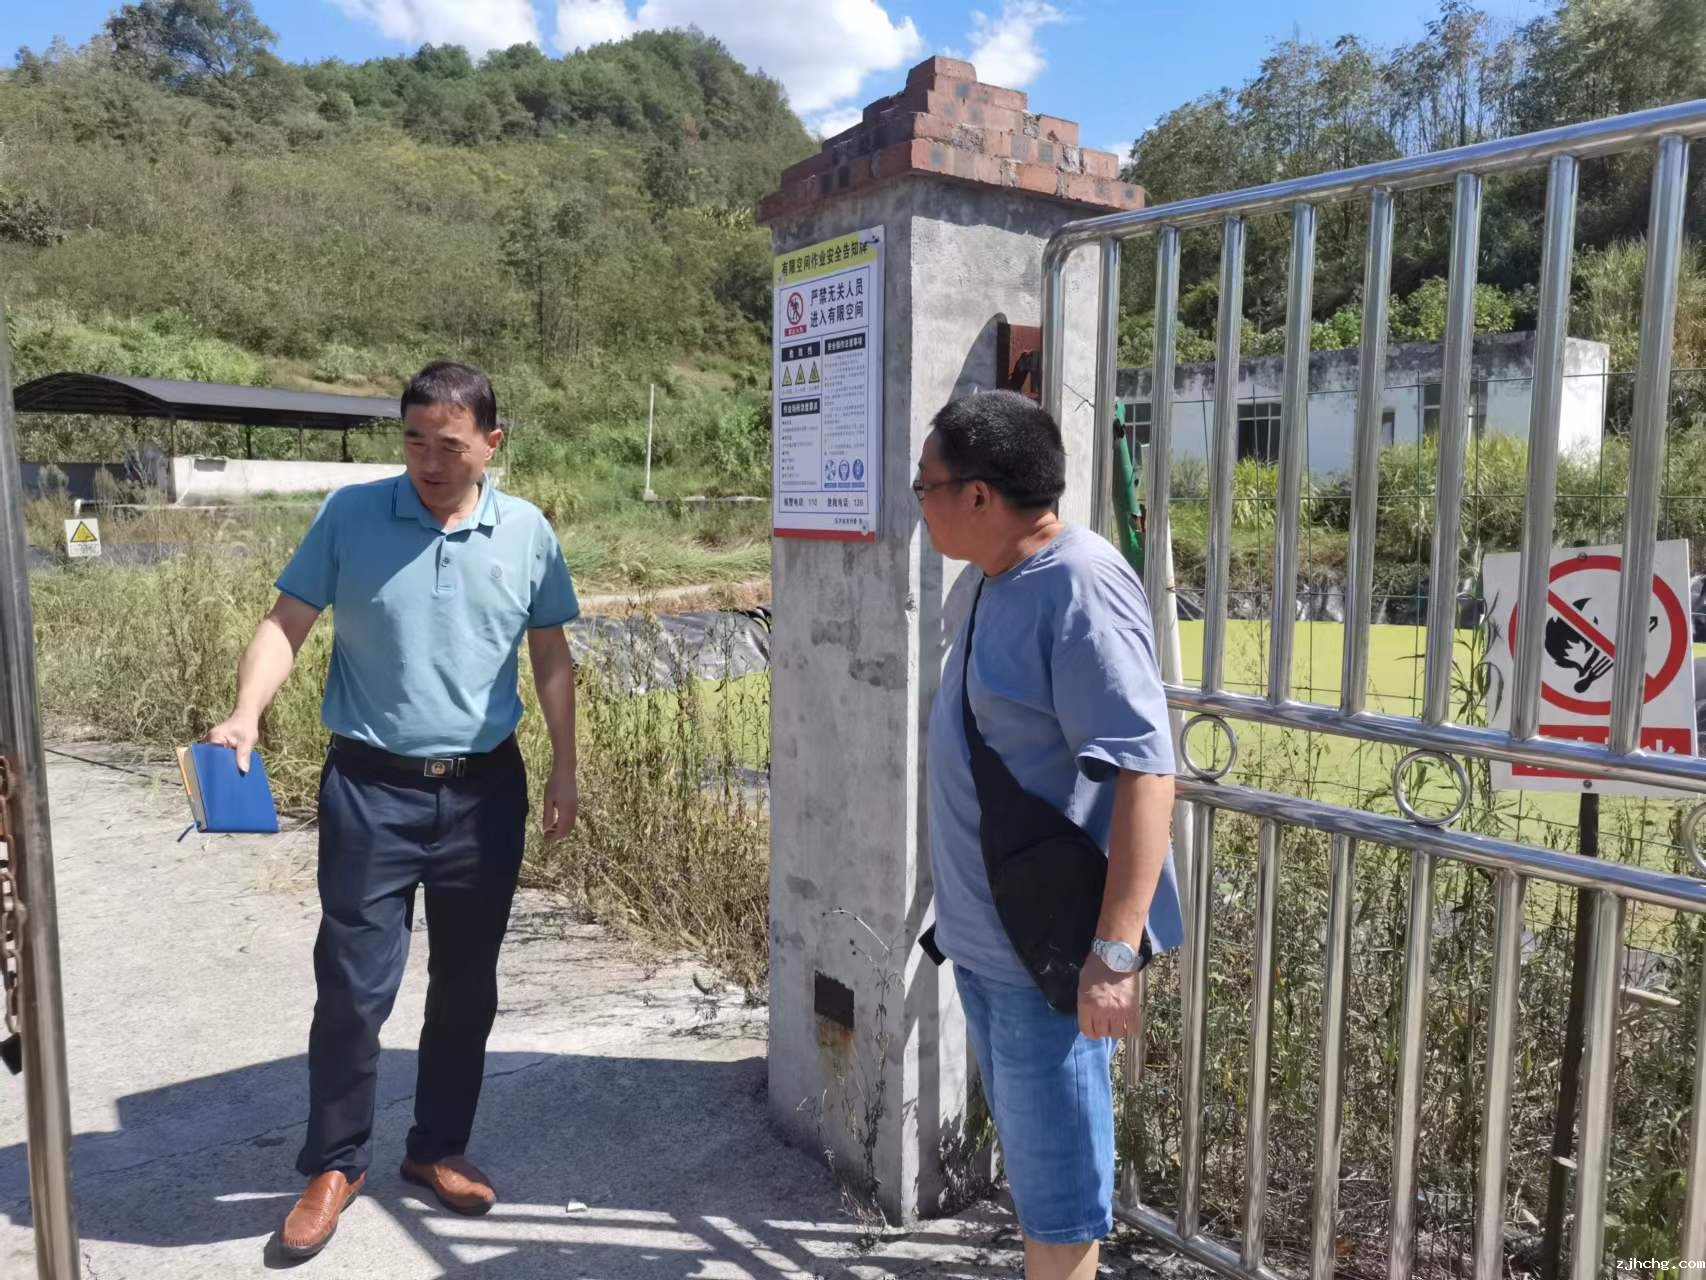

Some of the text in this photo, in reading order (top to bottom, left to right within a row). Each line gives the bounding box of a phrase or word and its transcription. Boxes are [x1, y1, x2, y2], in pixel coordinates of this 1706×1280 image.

[810, 278, 864, 306] 严禁无关人员
[810, 301, 864, 328] 进入有限空间
